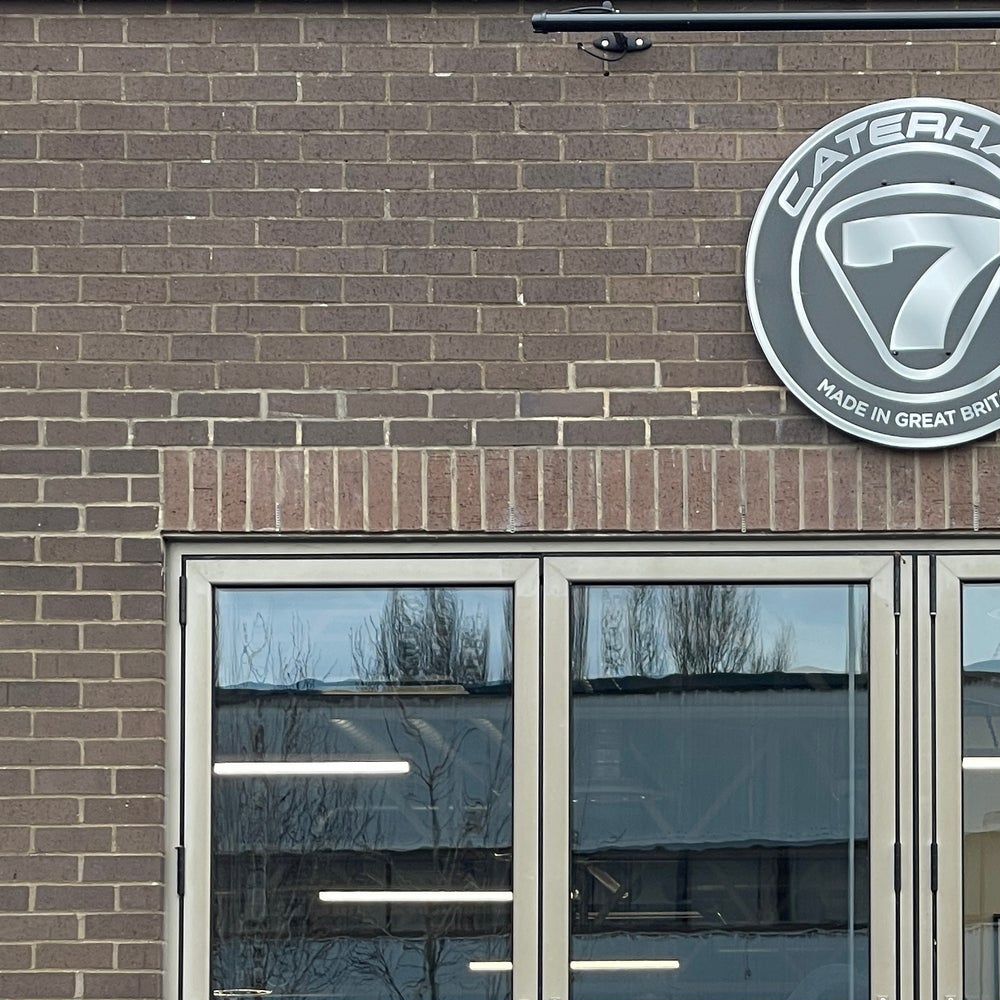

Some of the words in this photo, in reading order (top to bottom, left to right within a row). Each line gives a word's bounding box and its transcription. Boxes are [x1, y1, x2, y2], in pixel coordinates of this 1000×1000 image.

[816, 378, 870, 418] MADE
[871, 406, 891, 425] IN
[895, 410, 956, 429] GREAT
